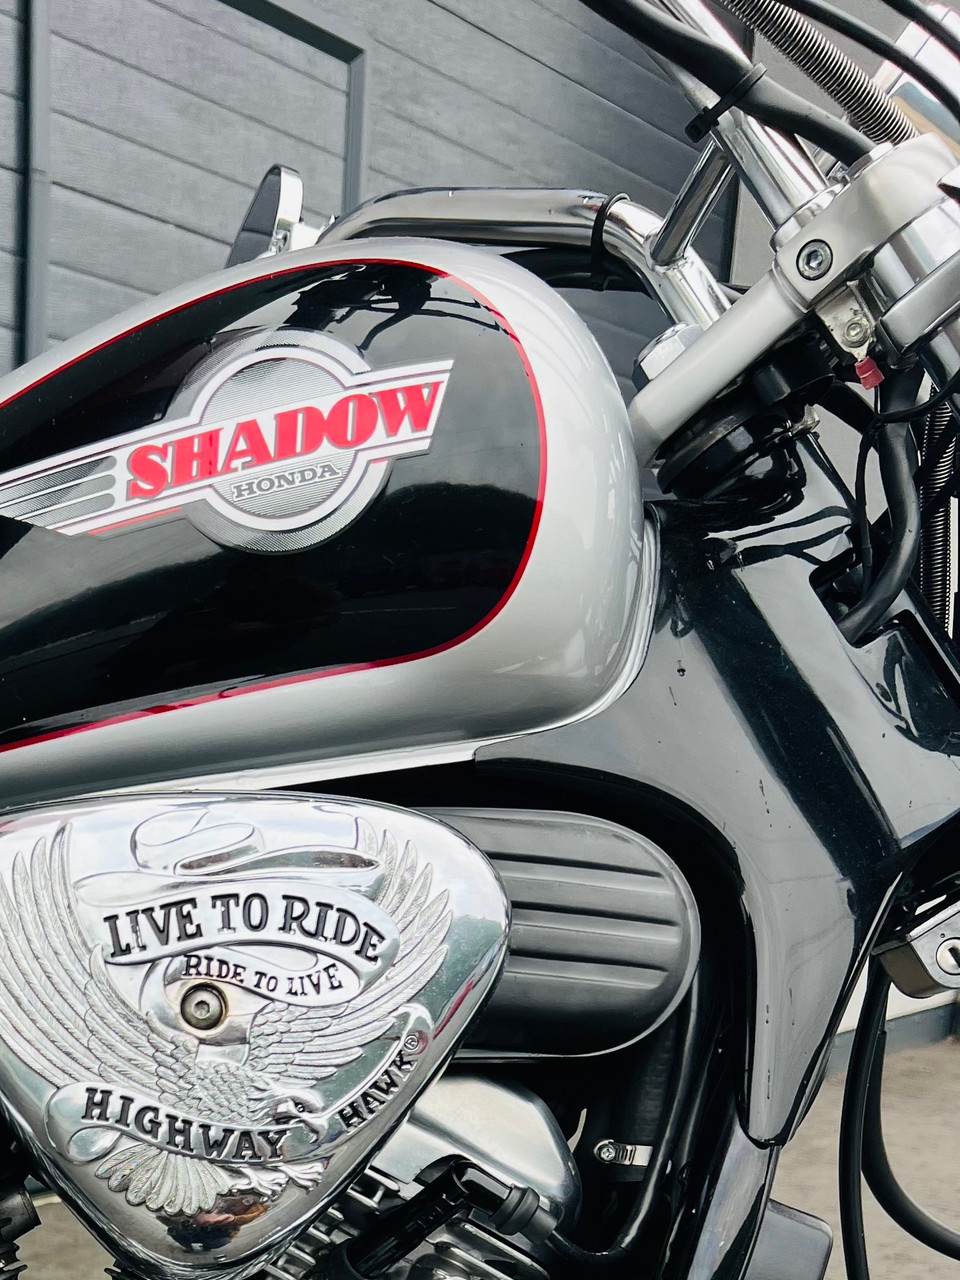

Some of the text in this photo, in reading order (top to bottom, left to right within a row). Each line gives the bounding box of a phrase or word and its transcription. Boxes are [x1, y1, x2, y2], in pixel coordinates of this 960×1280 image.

[127, 379, 444, 499] SHADOW
[232, 461, 341, 501] HONDA
[103, 892, 386, 964] LIVE TO RIDE
[181, 954, 344, 997] RIDE TO LIVE
[80, 1086, 289, 1162] HIGHWAY
